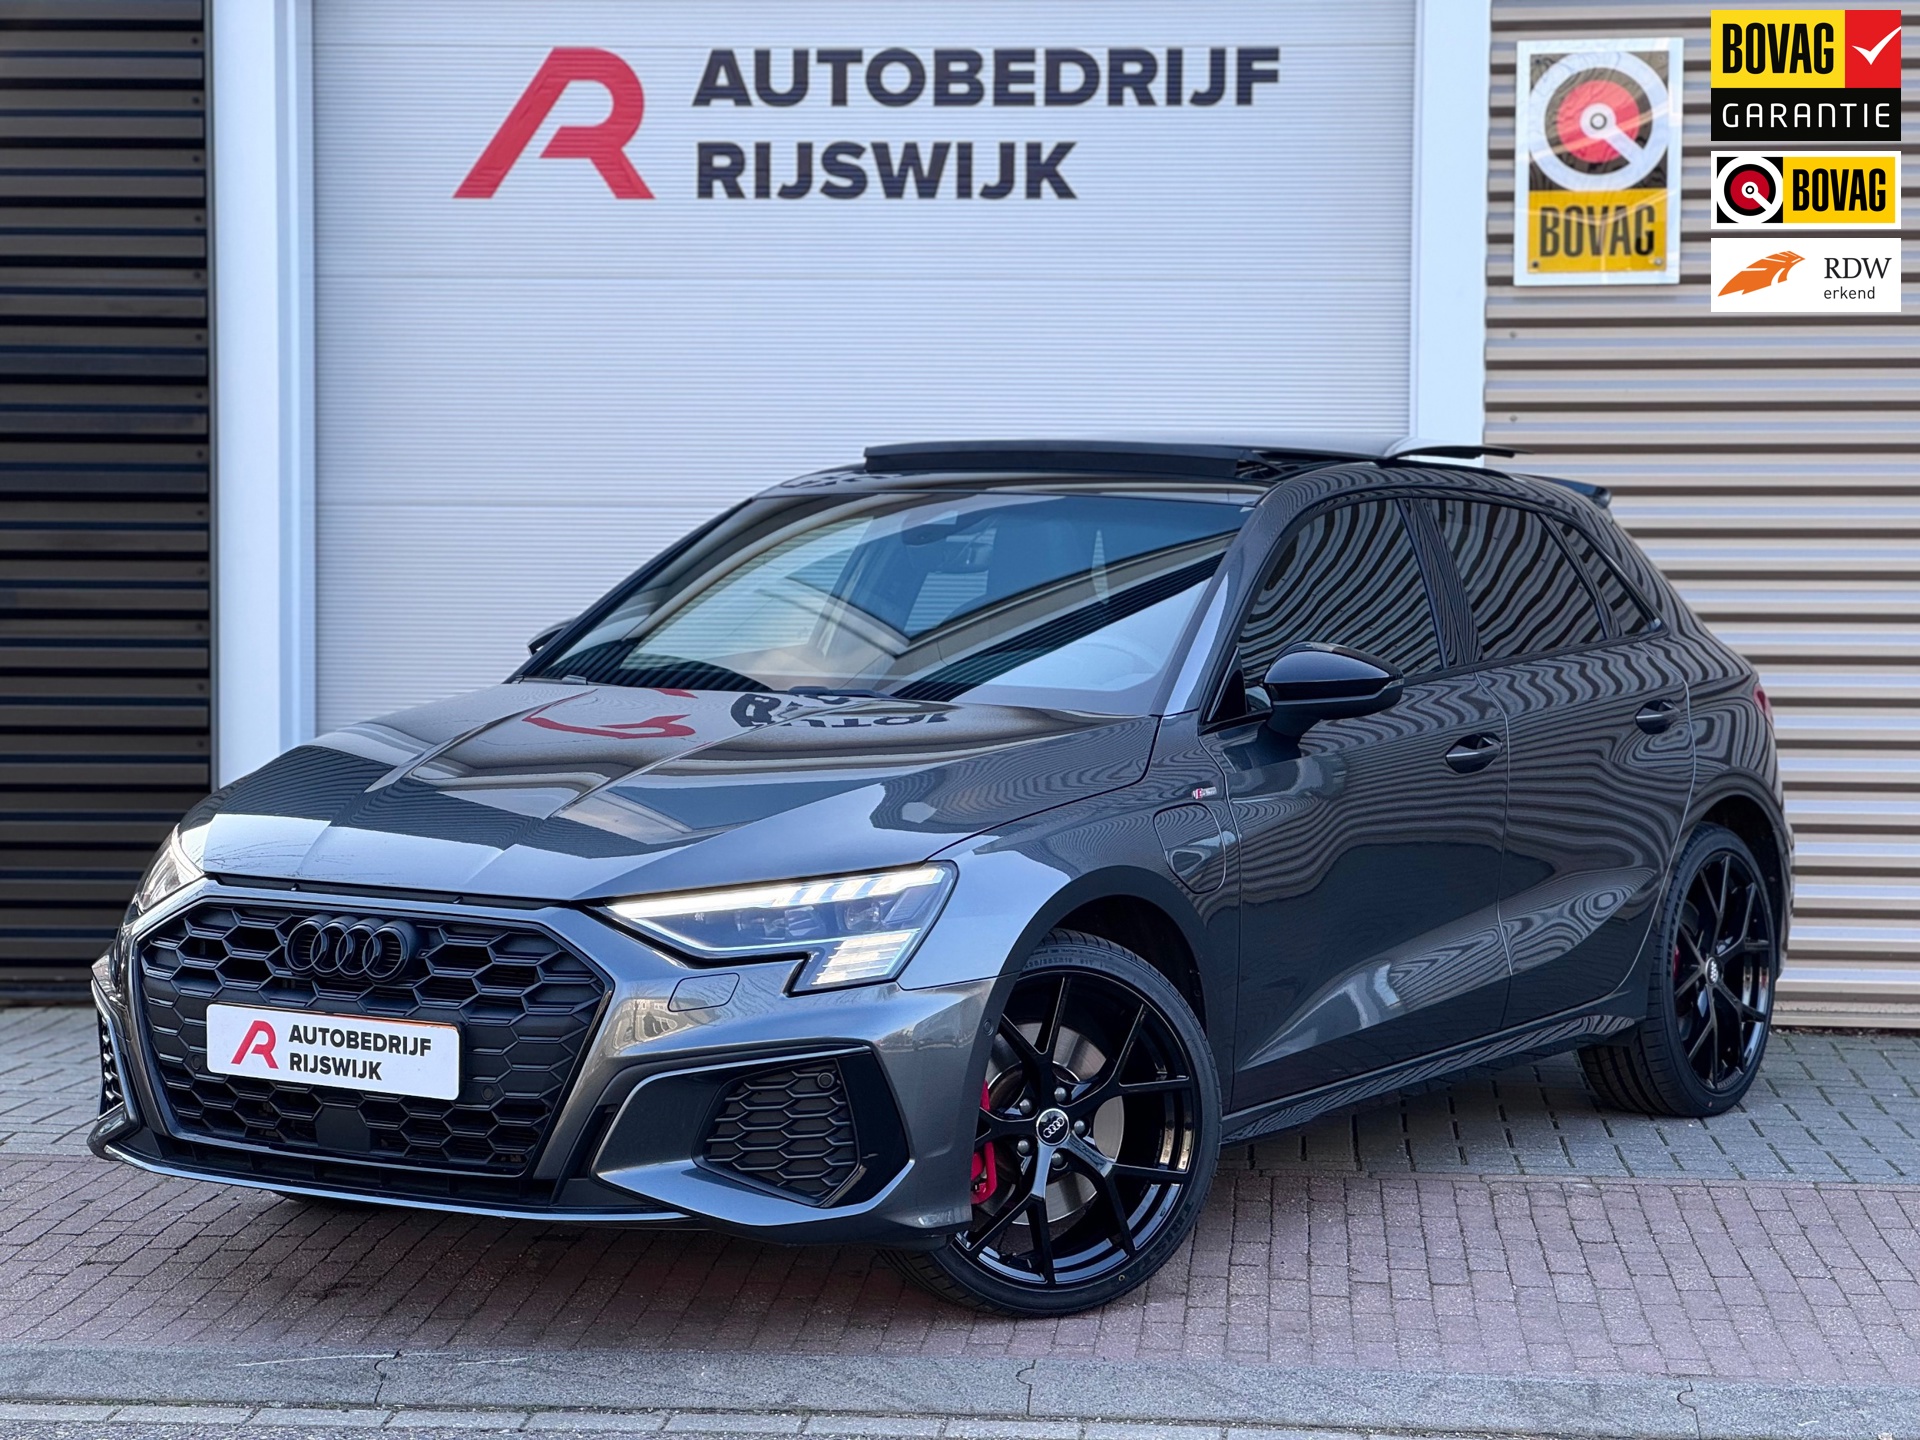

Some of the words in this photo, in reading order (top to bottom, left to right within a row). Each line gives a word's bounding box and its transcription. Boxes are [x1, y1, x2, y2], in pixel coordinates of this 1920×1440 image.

[692, 47, 1280, 108] AUTOBEDRIJF
[697, 141, 1078, 200] RIJSWIJK
[1539, 204, 1656, 258] BOVAG
[288, 1024, 432, 1057] AUTOBEDRIJF
[289, 1053, 382, 1081] RIJSWIJK
